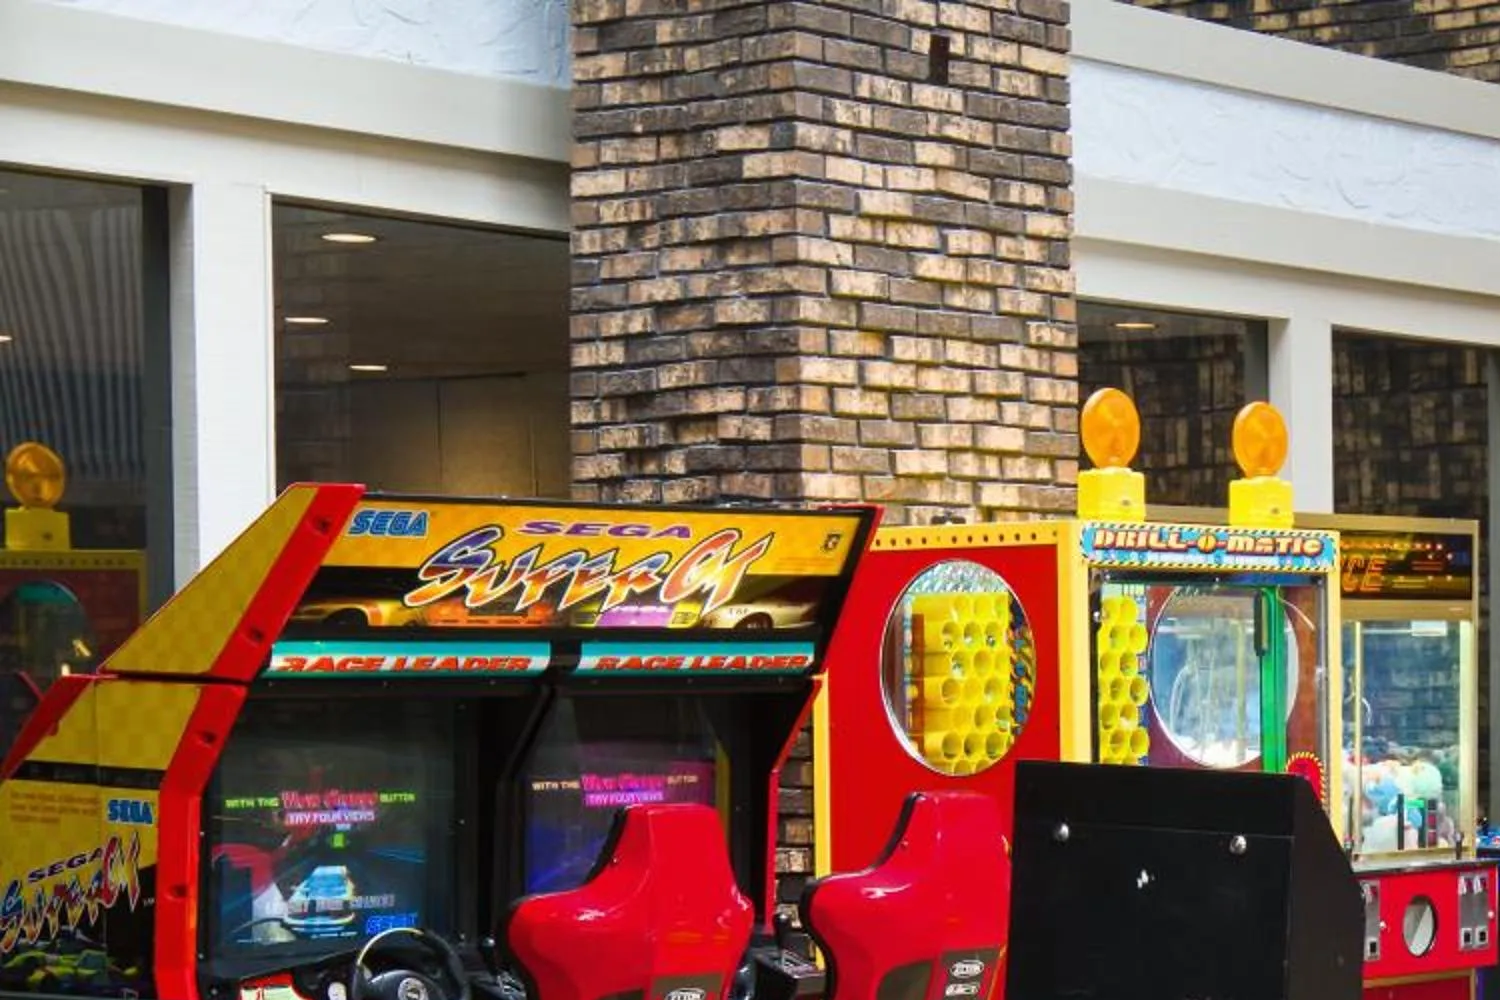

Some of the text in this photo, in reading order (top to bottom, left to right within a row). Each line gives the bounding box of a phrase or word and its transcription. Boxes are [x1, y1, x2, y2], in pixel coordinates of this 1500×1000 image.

[348, 510, 427, 536] SEGA
[518, 520, 692, 539] SEGA
[1092, 527, 1327, 558] DRILL-O-MATIC
[403, 527, 776, 616] SUPER GT
[278, 656, 531, 672] RACE LEADER
[595, 656, 809, 669] RACE LEADER
[108, 799, 153, 824] SEGA
[28, 847, 104, 883] SEGA
